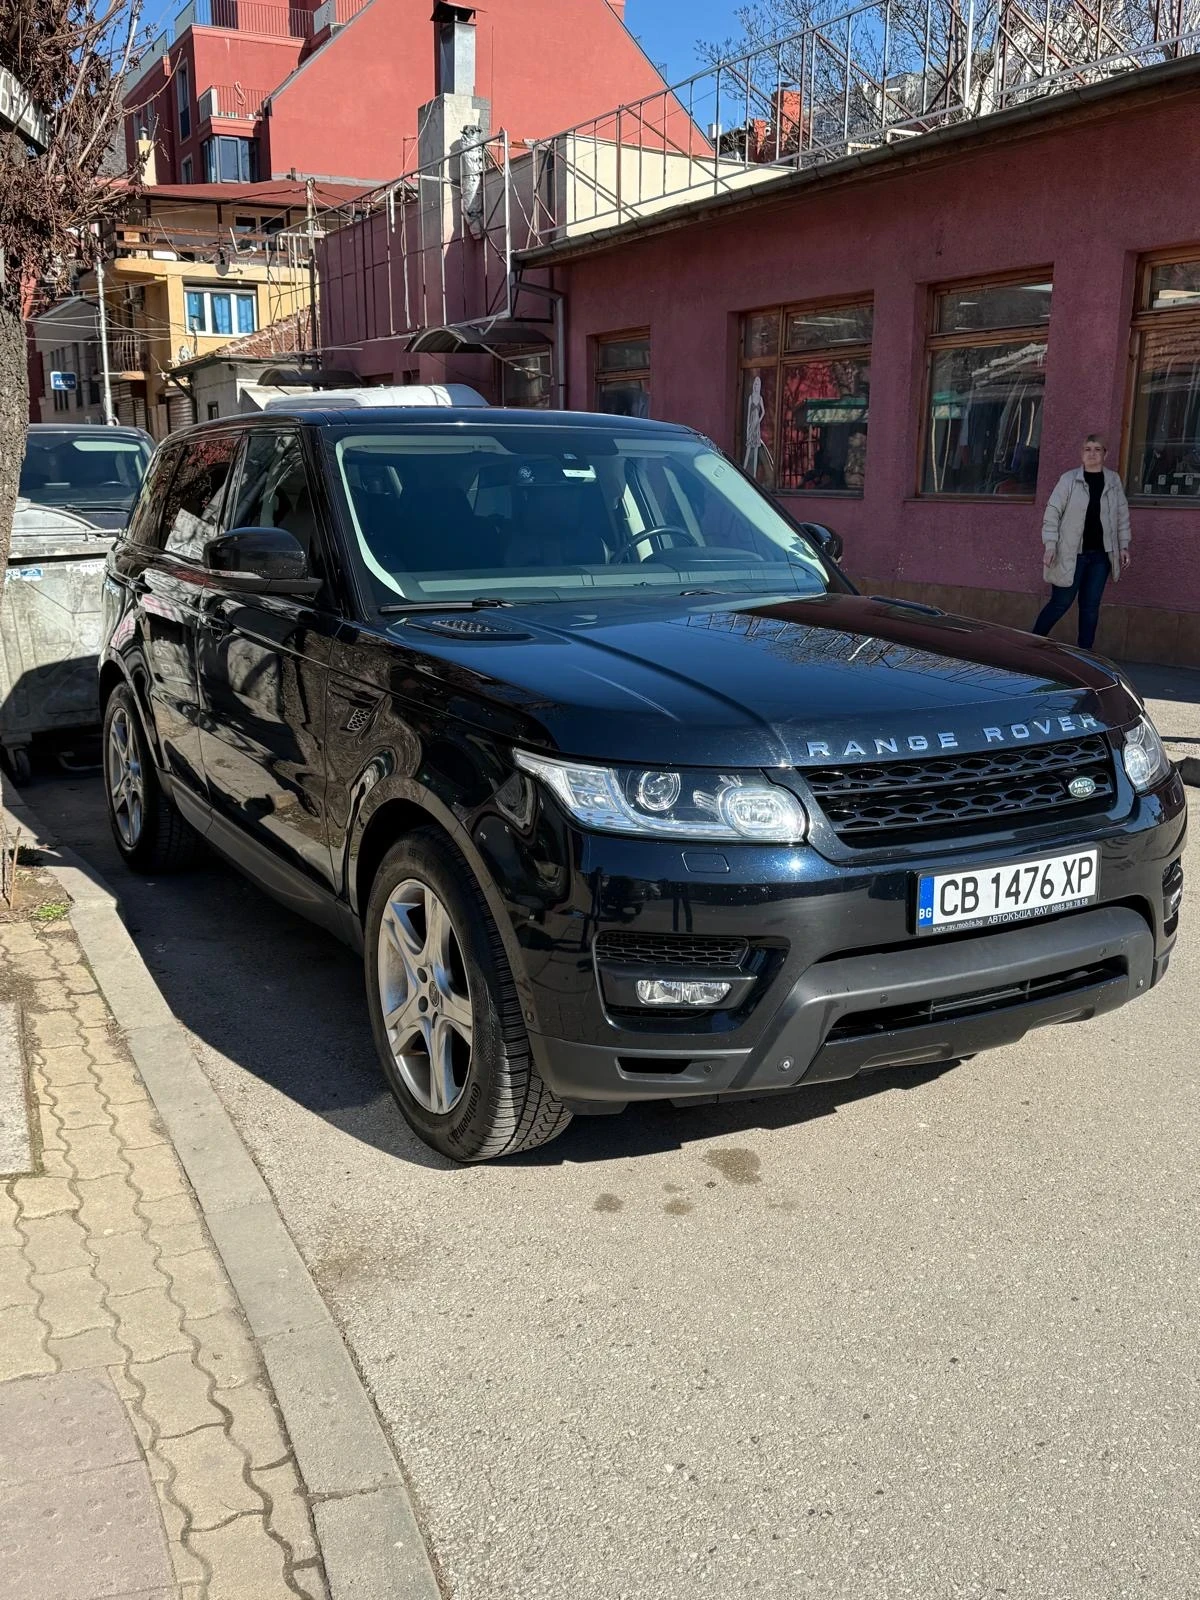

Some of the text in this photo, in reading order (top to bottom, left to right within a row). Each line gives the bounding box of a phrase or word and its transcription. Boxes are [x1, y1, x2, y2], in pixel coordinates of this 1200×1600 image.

[806, 713, 1097, 757] RANGE ROVER
[991, 863, 1055, 909] 1476
[919, 908, 932, 919] BG
[1034, 904, 1050, 917] RAY
